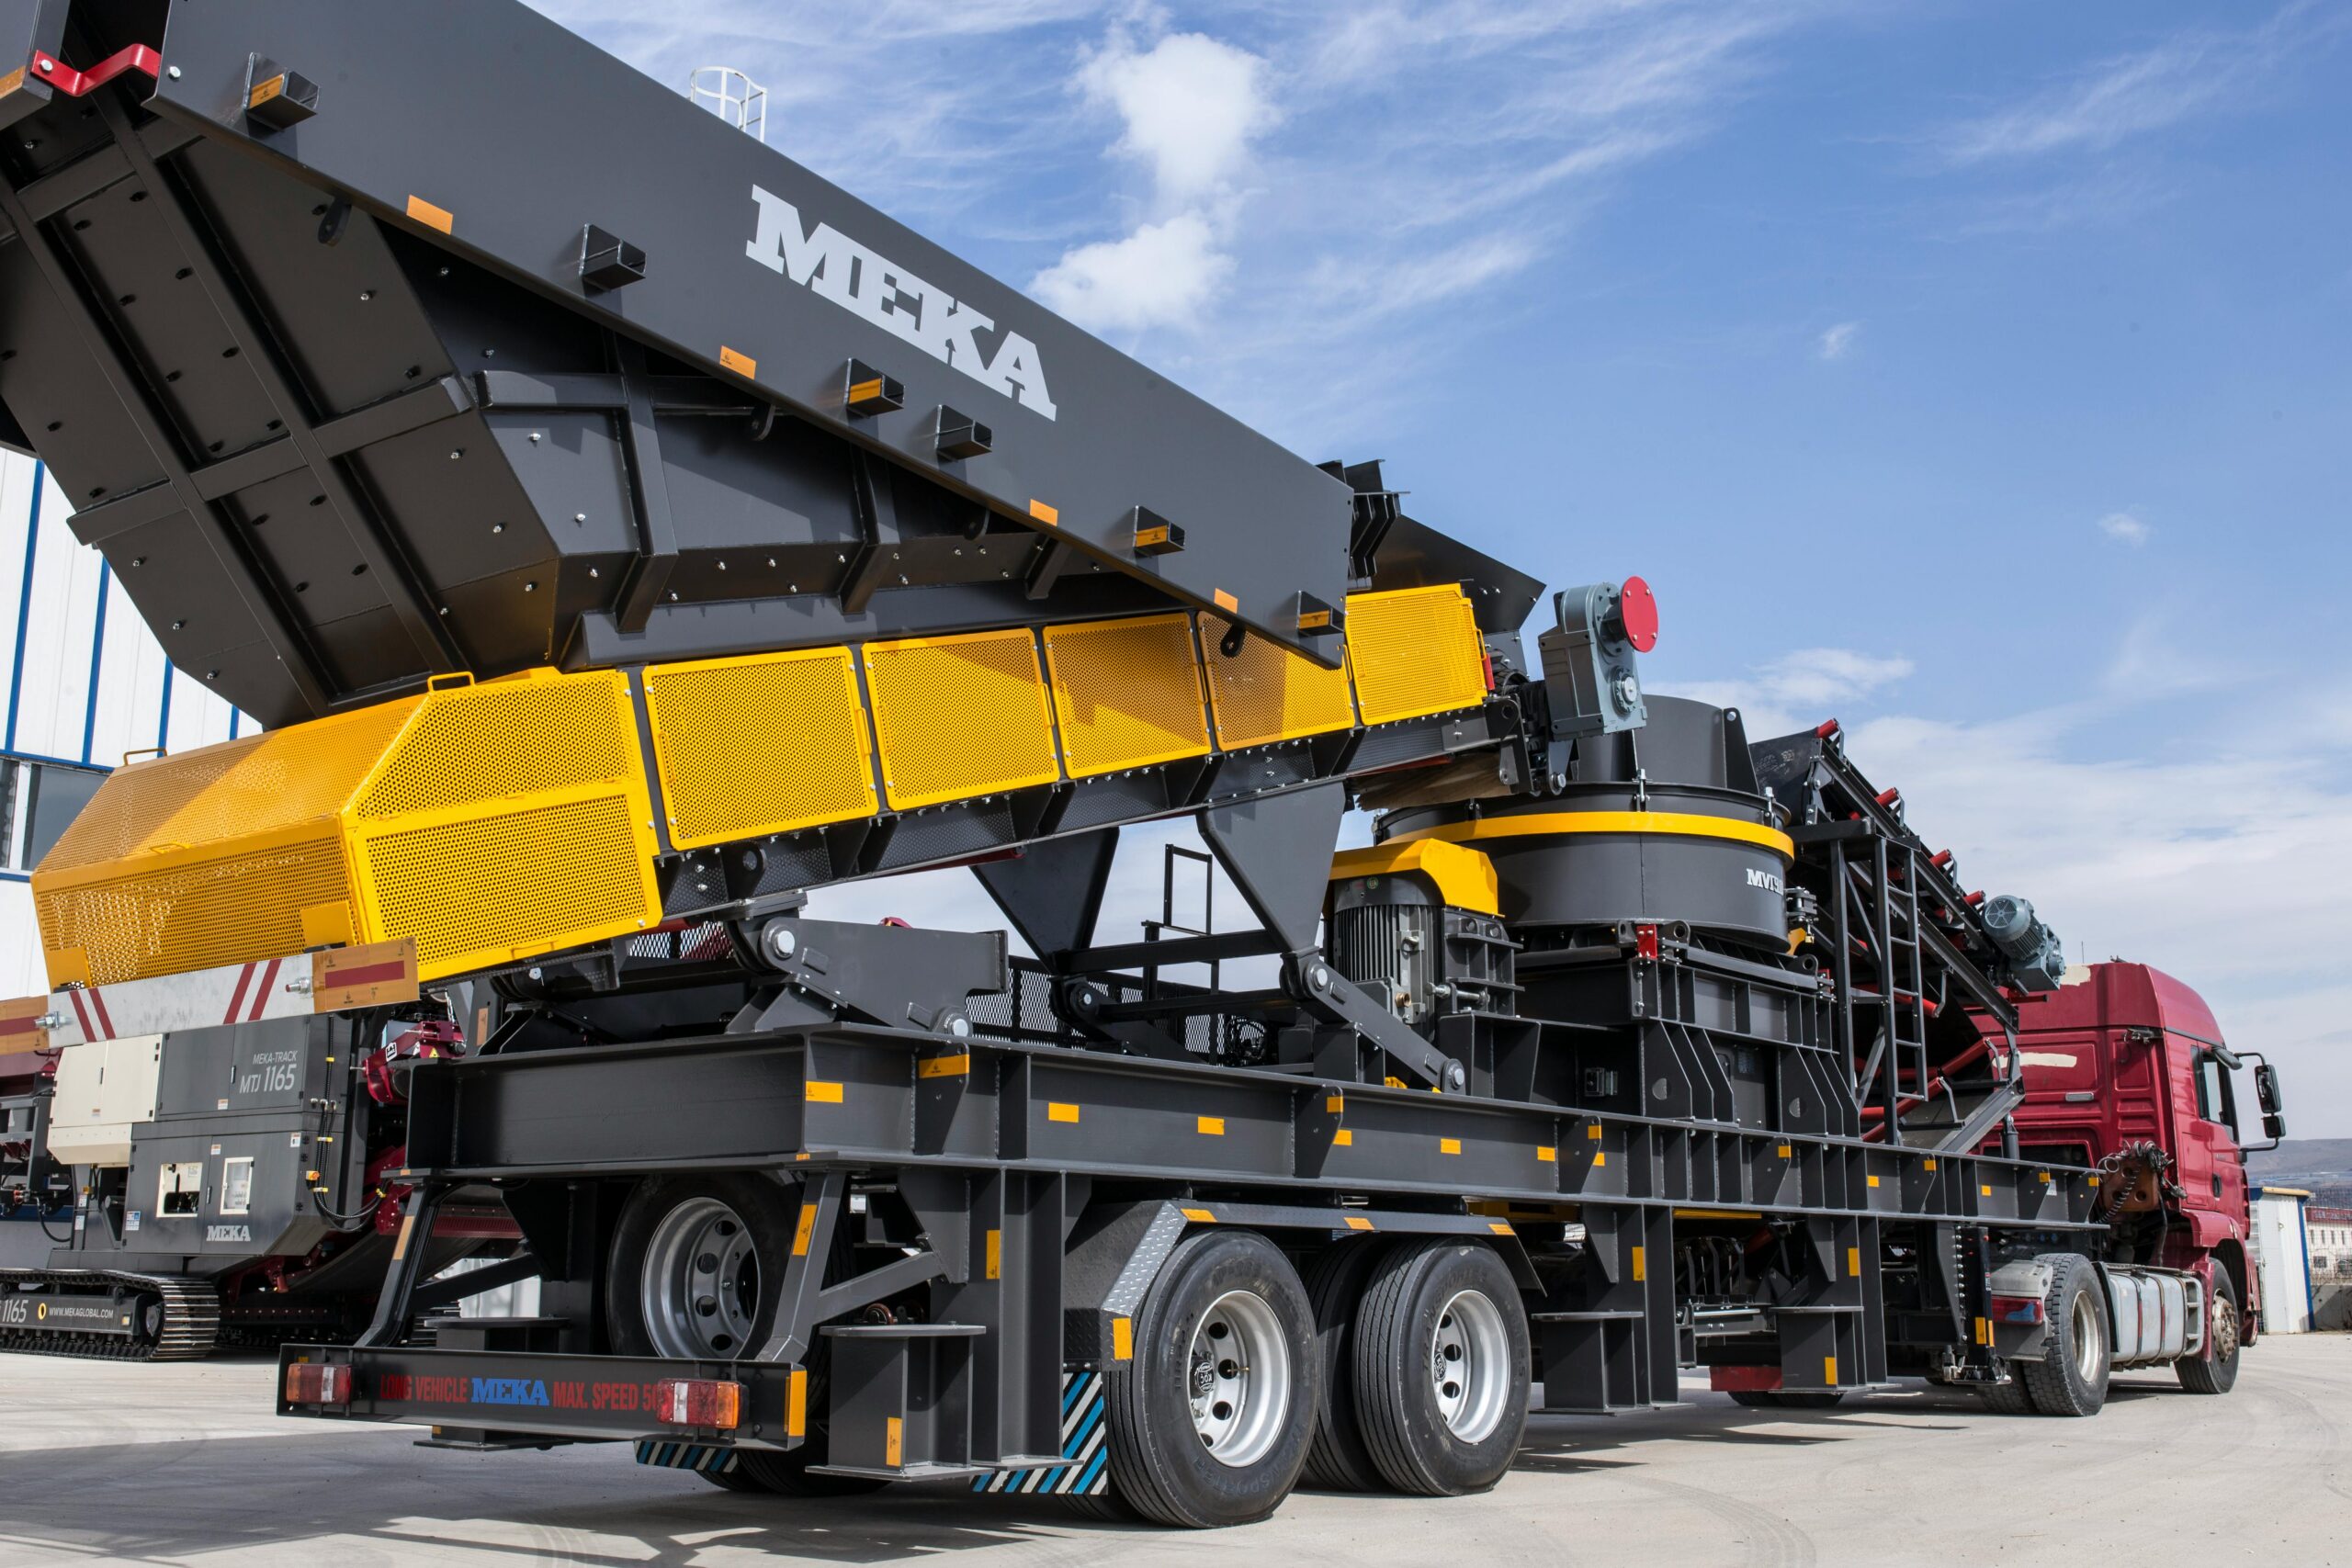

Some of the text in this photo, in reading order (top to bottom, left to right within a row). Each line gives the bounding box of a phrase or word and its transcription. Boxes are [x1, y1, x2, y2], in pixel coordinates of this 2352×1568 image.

[745, 183, 1057, 422] MEKA
[253, 1051, 299, 1065] MEKA-TRACK
[239, 1063, 297, 1094] MTJ 1165
[206, 1224, 251, 1242] MEKA
[2, 1299, 114, 1323] 1165 WWW.MEKAGLOBAL.COM
[380, 1374, 412, 1401] LONG
[414, 1375, 468, 1404] VEHICLE
[470, 1377, 549, 1406] MEKA
[553, 1381, 589, 1409] MAX.
[592, 1382, 639, 1412] SPEED
